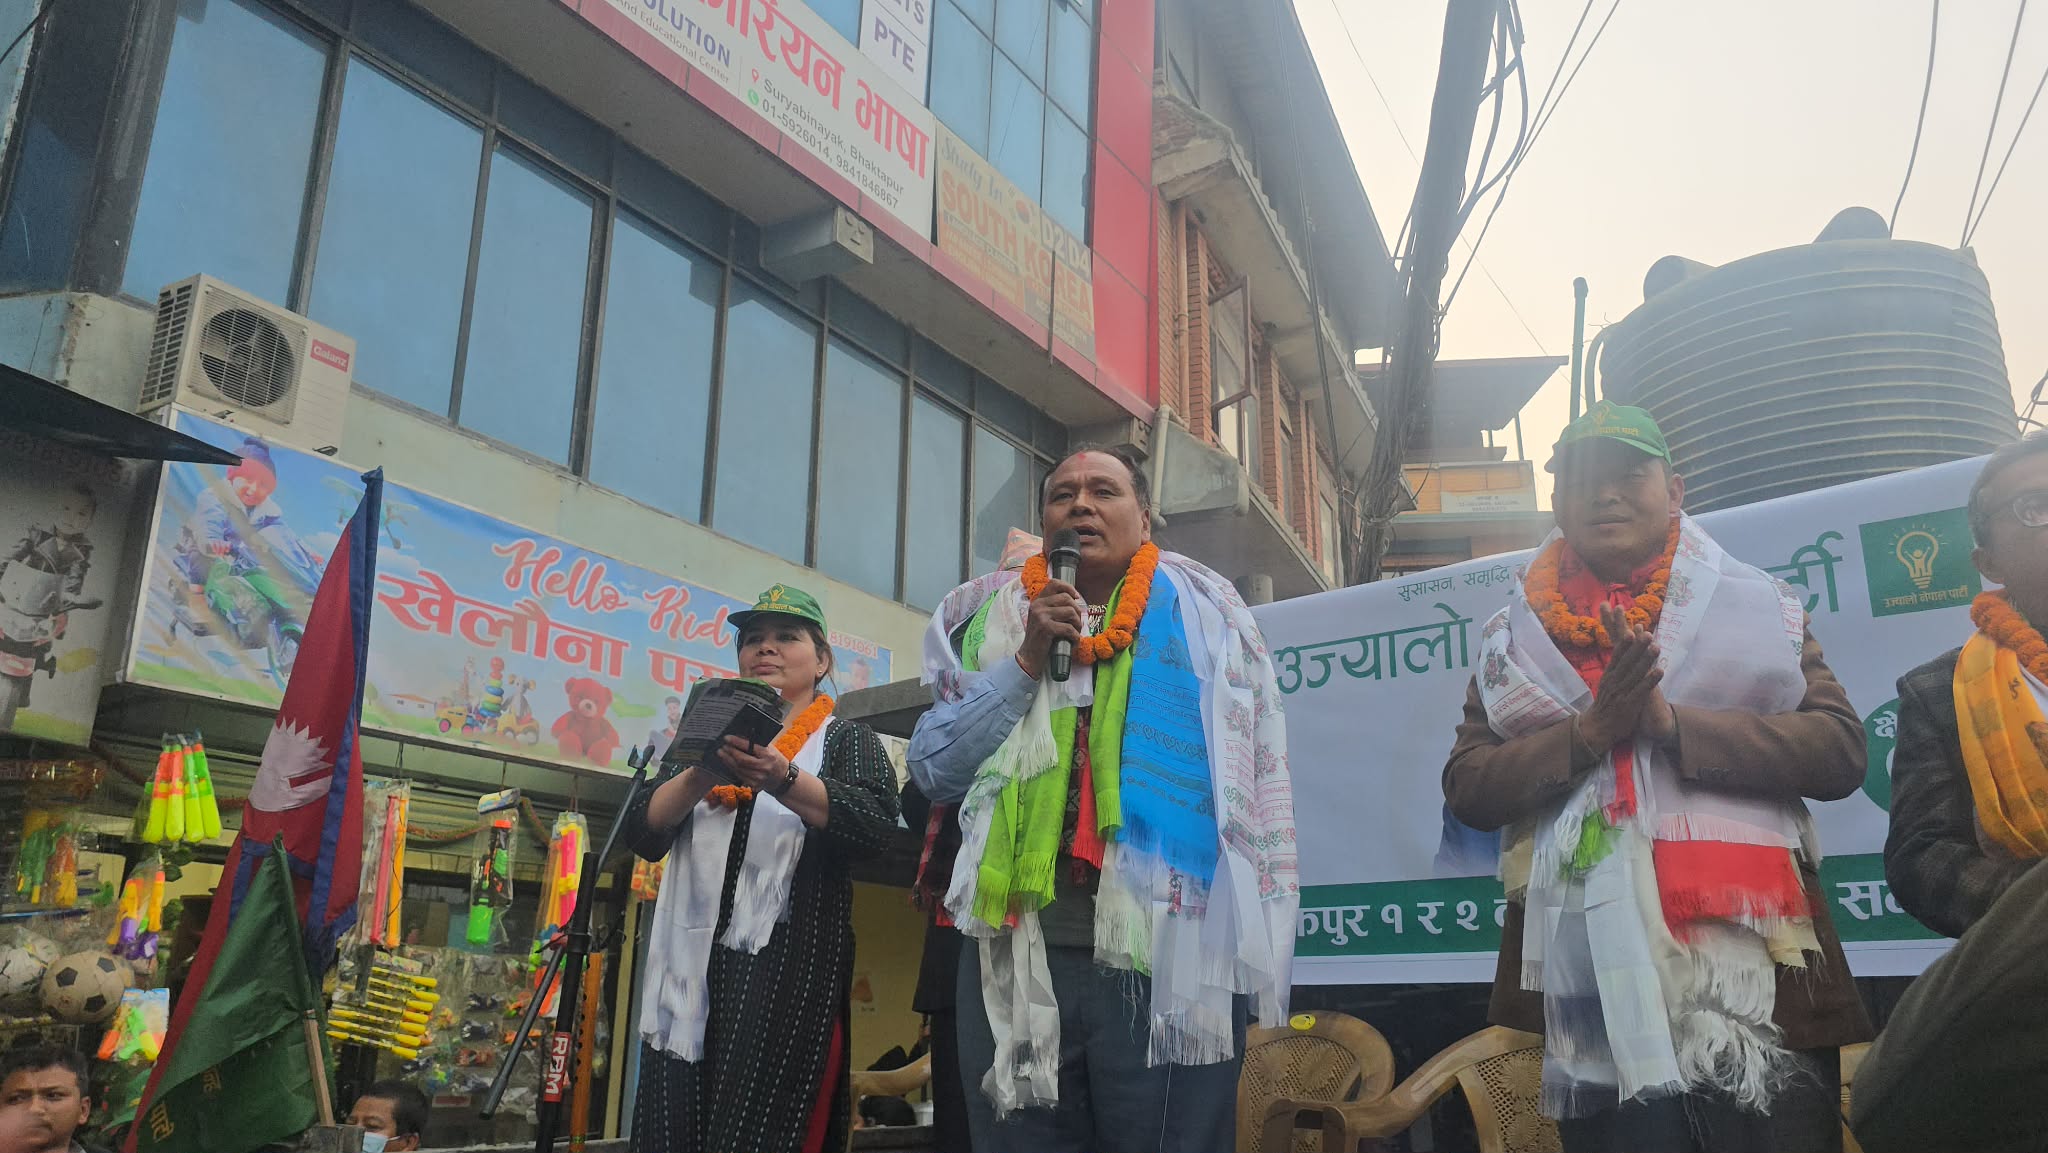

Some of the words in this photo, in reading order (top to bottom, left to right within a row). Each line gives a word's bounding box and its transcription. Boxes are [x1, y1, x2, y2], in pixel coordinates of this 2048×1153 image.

[640, 11, 697, 59] Educational
[699, 56, 729, 84] Center
[874, 16, 915, 72] PTE
[762, 101, 833, 163] 01-5926014,
[836, 154, 899, 209] 9841846867
[764, 78, 846, 153] Suryabinayak,
[850, 145, 904, 195] Bhaktapur
[855, 79, 929, 179] भाषा
[942, 169, 1018, 261] SOUTH
[1023, 233, 1092, 321] KOREA
[313, 345, 348, 369] Galanz
[494, 540, 628, 613] Hello
[377, 571, 628, 678] खेलौना
[1274, 602, 1473, 695] उज्यालो
[1381, 904, 1403, 934] १
[1417, 902, 1444, 934] र
[1456, 900, 1479, 930] २
